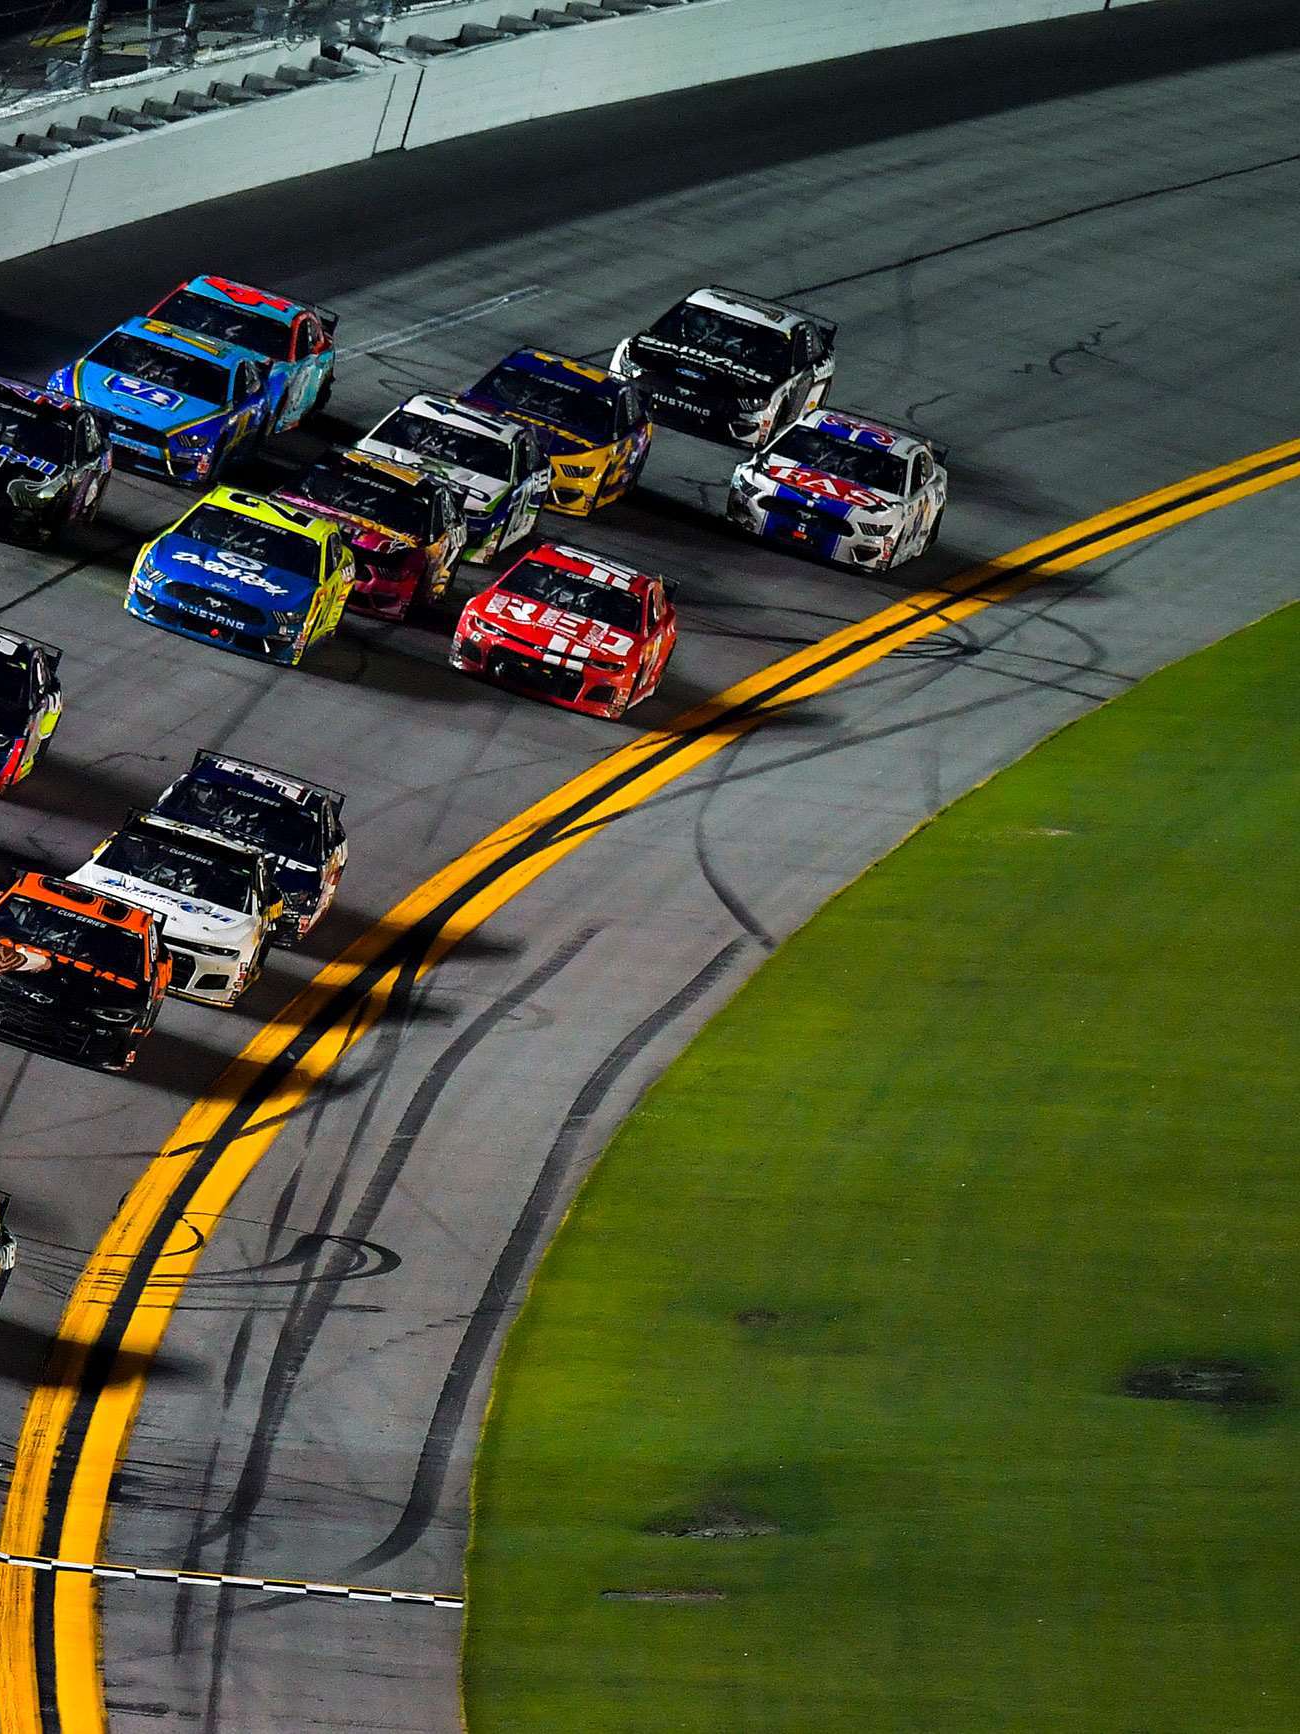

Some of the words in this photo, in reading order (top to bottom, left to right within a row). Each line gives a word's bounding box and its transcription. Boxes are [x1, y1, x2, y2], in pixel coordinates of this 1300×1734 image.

[178, 602, 245, 630] MUSTANG
[57, 909, 76, 919] CUP
[75, 915, 108, 929] SERIES
